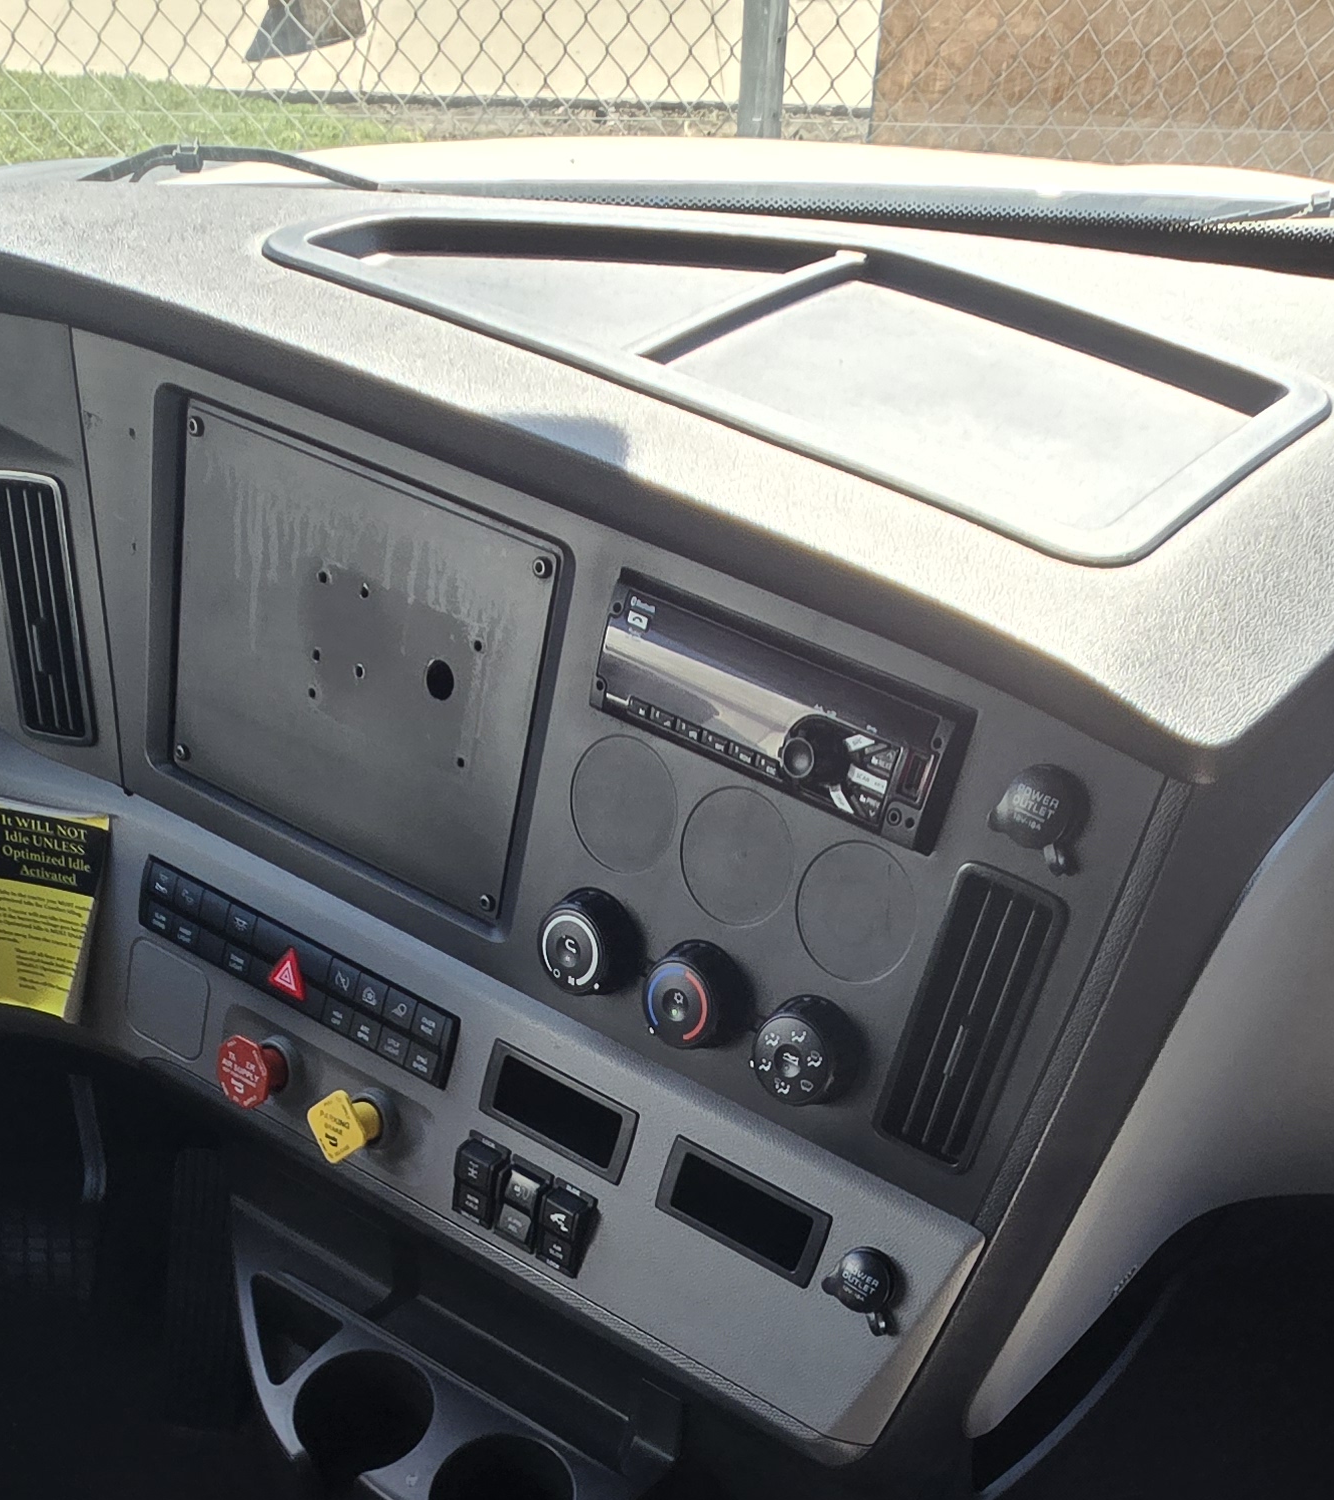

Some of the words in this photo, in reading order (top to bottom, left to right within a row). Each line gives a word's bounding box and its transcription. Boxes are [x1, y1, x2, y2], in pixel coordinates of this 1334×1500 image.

[1012, 794, 1055, 820] OUTLET
[1017, 783, 1060, 810] POWER
[1, 813, 13, 826] It
[15, 816, 54, 834] WILL
[56, 825, 88, 841] NOT
[5, 829, 30, 845] Idle
[32, 835, 86, 855] UNLESS
[2, 844, 65, 867] Optimized
[68, 857, 91, 873] Idle
[20, 864, 77, 886] Activated
[233, 1063, 260, 1083] SUPPLY
[841, 1269, 876, 1295] OUTLET
